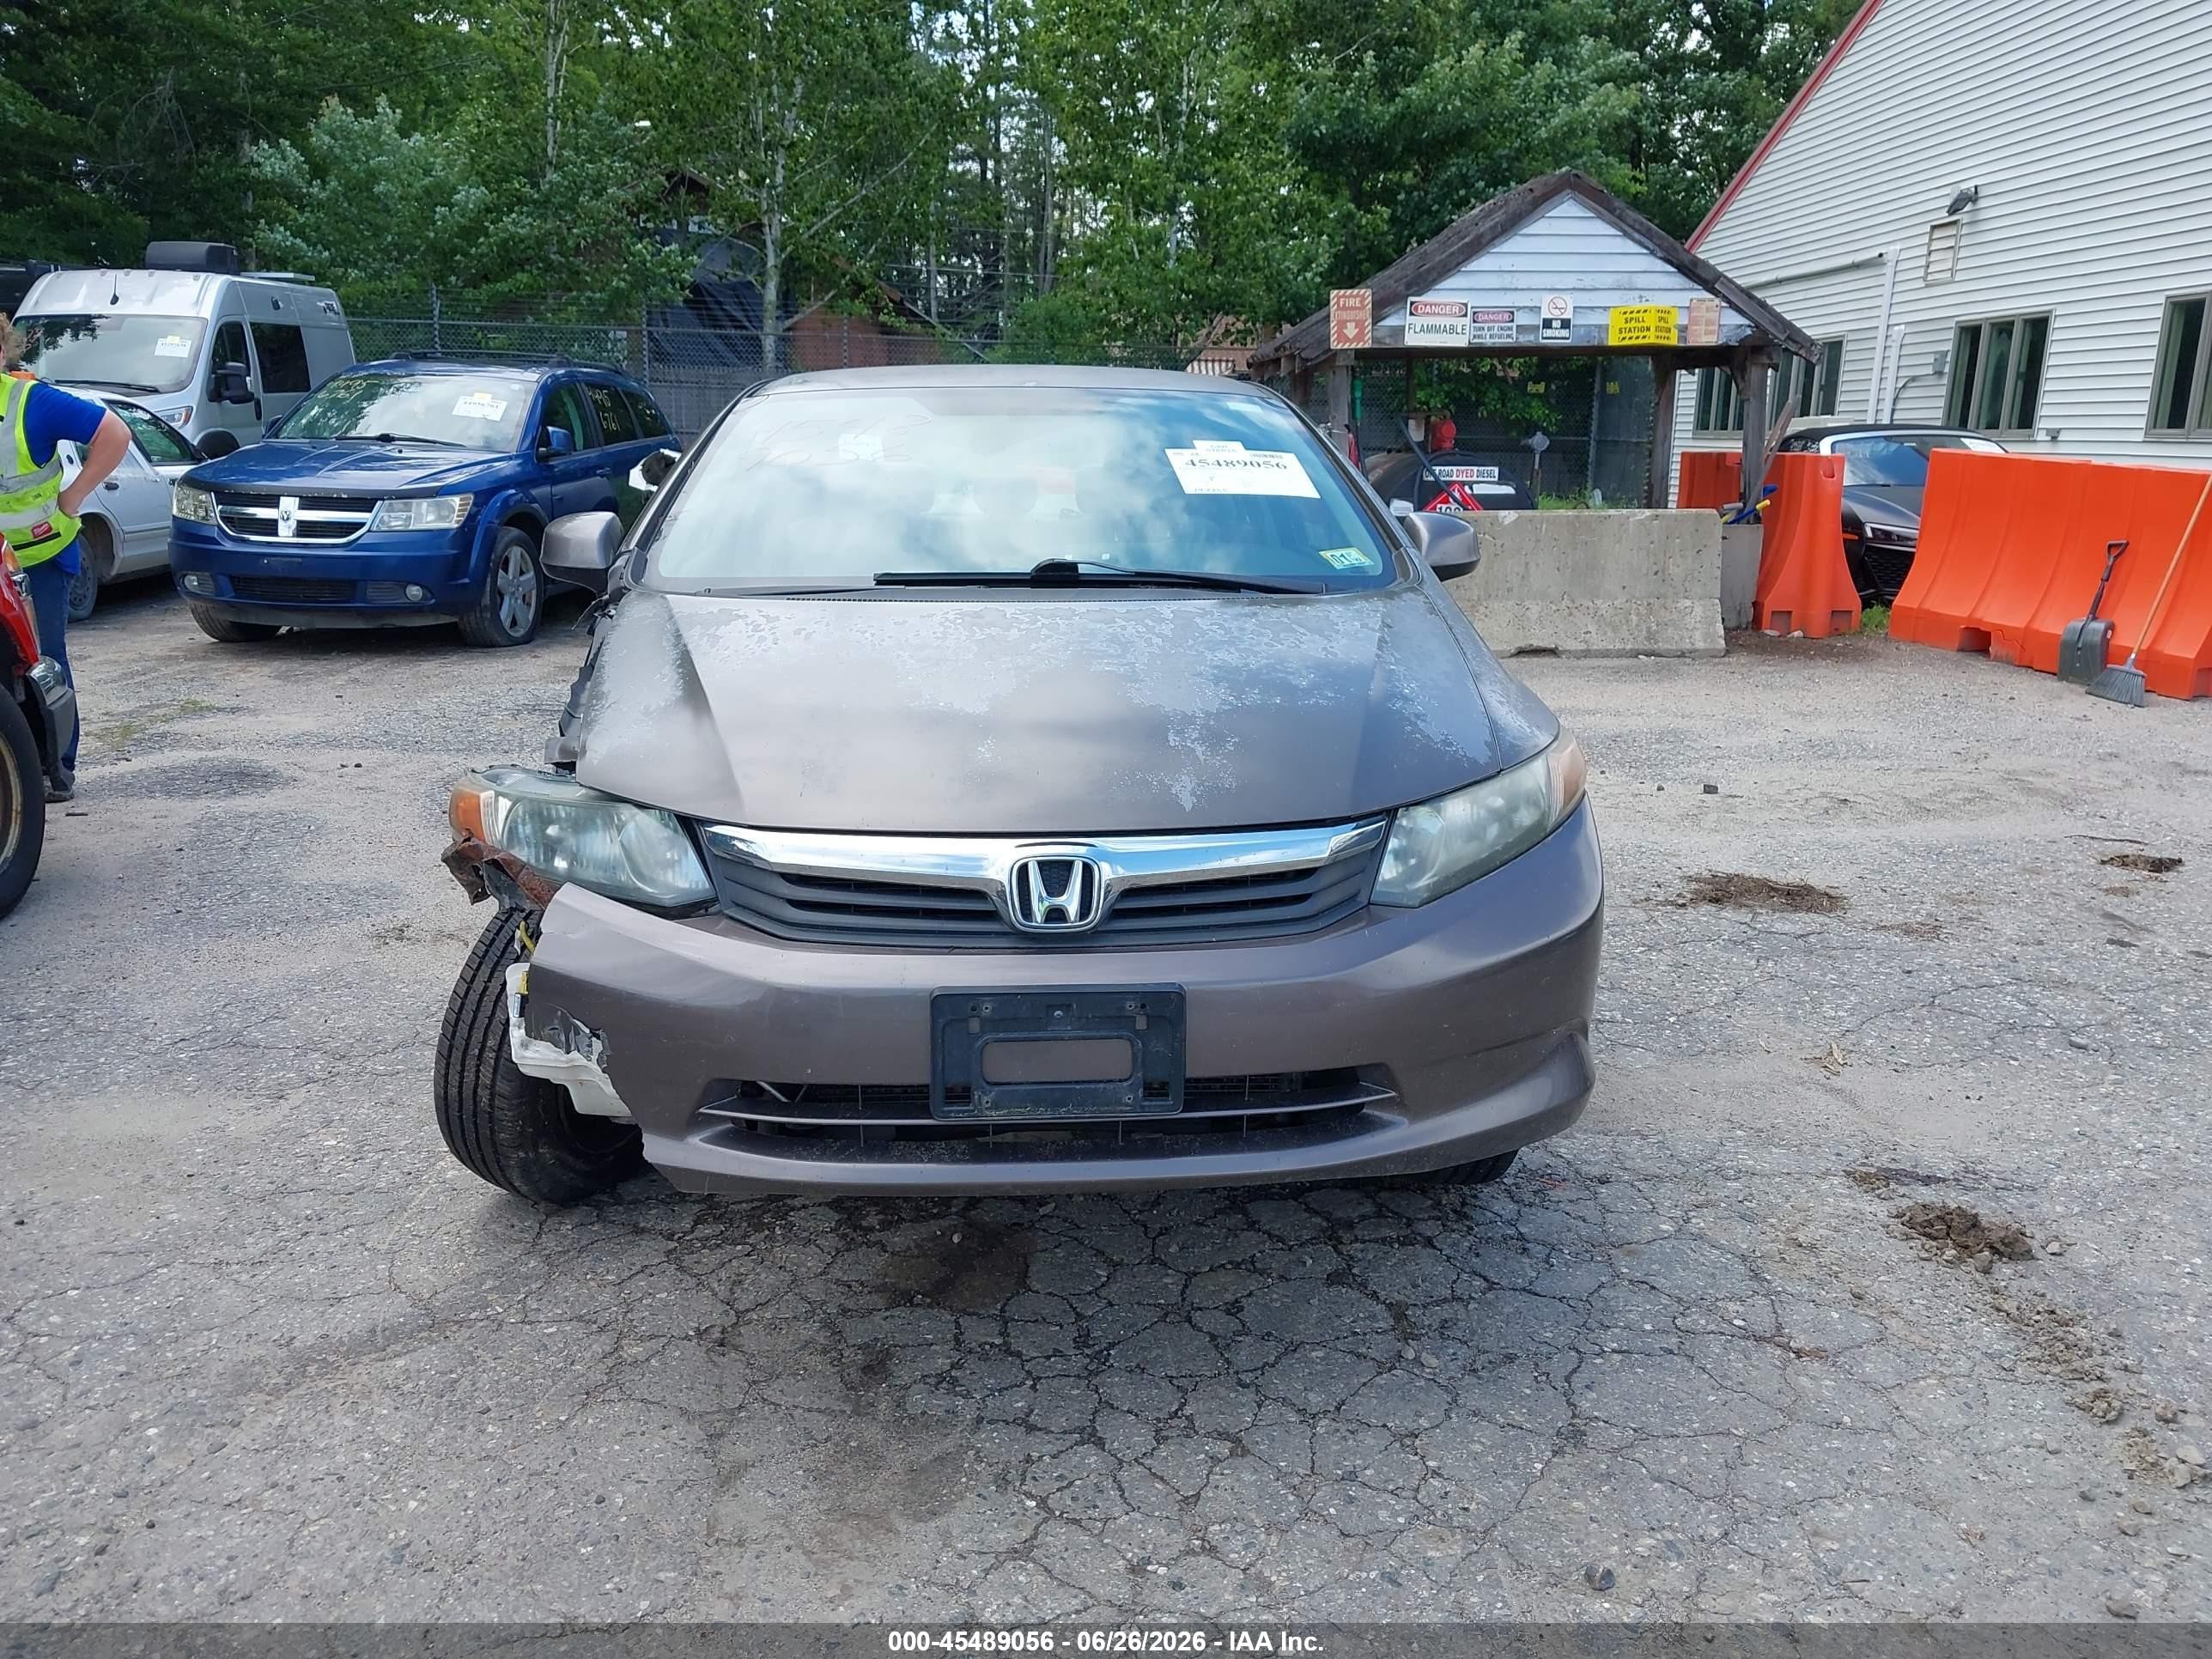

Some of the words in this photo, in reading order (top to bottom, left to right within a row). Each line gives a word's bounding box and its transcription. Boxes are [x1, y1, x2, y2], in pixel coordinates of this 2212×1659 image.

[1340, 297, 1361, 307] FIRE
[1418, 304, 1461, 314] DANGER
[1479, 313, 1510, 321] DANGER
[1624, 316, 1646, 325] SPILL
[1657, 315, 1669, 324] SPILL
[1552, 319, 1561, 328] NO
[1408, 323, 1468, 335] FLAMMABLE
[1542, 329, 1570, 337] SMOKING
[1618, 325, 1651, 335] STATION
[1655, 325, 1672, 334] STATION
[1185, 459, 1288, 470] 45489056
[1438, 469, 1455, 478] ROAD
[1455, 469, 1475, 478] DYED
[1476, 469, 1497, 478] DIESEL
